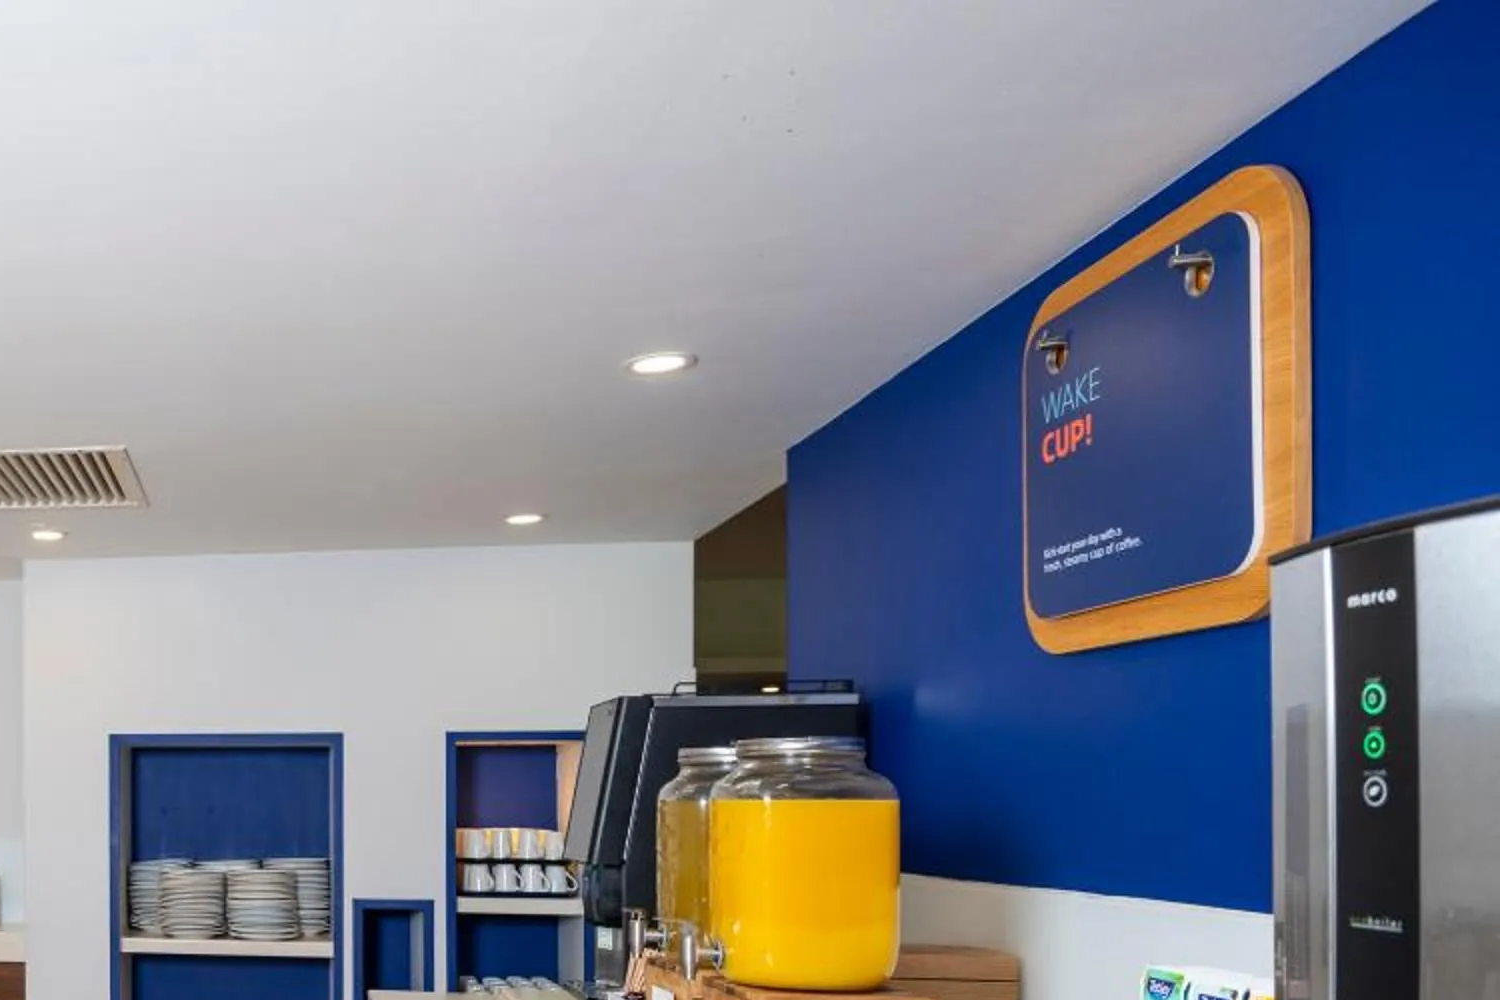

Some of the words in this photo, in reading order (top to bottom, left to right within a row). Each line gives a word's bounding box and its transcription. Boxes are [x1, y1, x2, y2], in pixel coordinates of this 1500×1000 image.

[1041, 367, 1100, 424] WAKE
[1043, 413, 1092, 464] CUP!
[1347, 587, 1398, 609] marco
